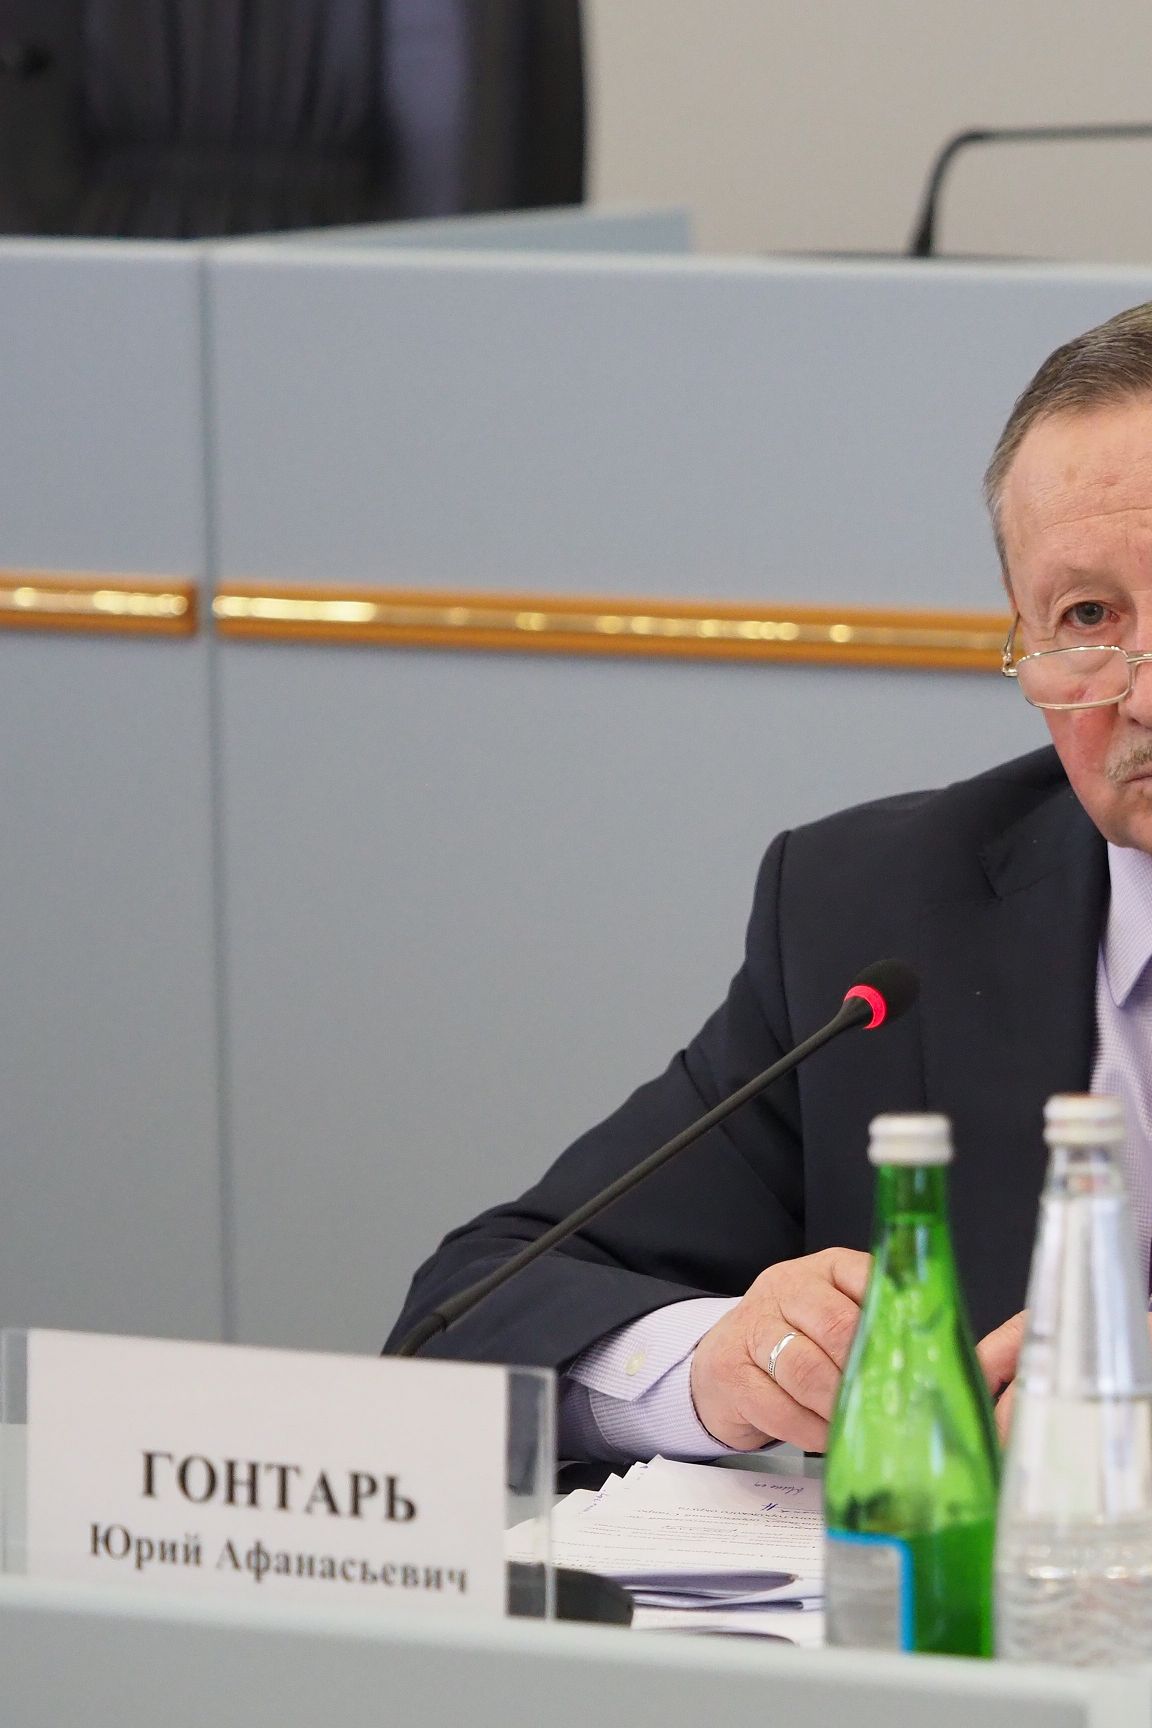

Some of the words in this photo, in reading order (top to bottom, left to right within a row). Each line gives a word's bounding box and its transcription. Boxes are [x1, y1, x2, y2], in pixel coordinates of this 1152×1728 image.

[141, 1450, 418, 1523] ГОНТАРЬ
[89, 1522, 202, 1570] Юрий
[215, 1538, 468, 1594] Афанасьевич
